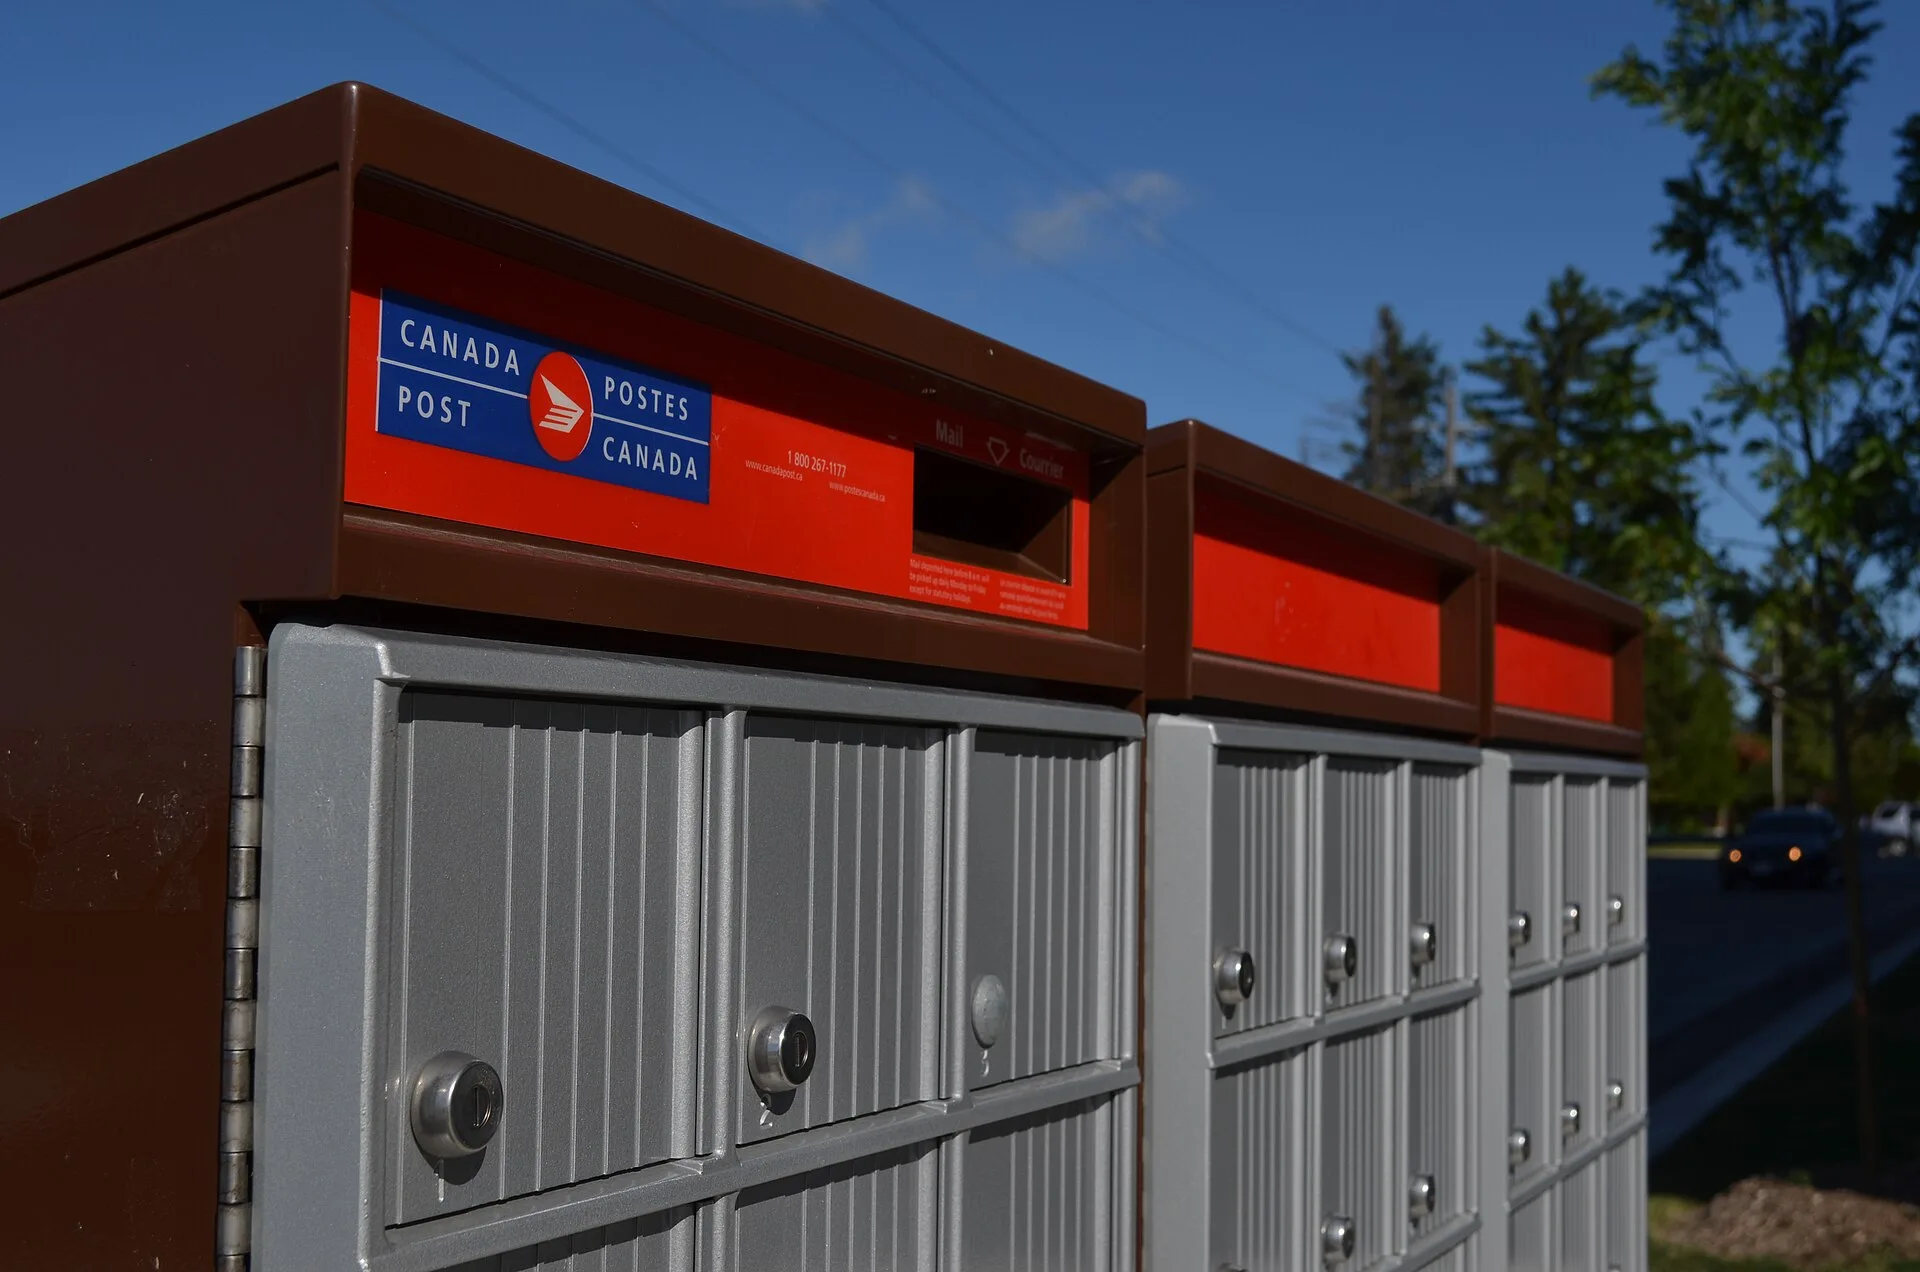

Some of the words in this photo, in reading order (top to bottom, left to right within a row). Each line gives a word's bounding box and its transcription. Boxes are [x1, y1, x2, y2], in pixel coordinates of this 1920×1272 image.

[399, 318, 520, 376] CANADA
[398, 385, 471, 428] POST
[604, 375, 689, 421] POSTES
[936, 419, 963, 448] Mail
[603, 436, 698, 481] CANADA
[745, 459, 803, 482] www.canadapost.ca
[788, 450, 792, 464] 1
[794, 451, 810, 469] 800
[811, 456, 847, 478] 267-1177
[1020, 447, 1064, 479] Courrier
[829, 481, 886, 502] www.postescanada.ca
